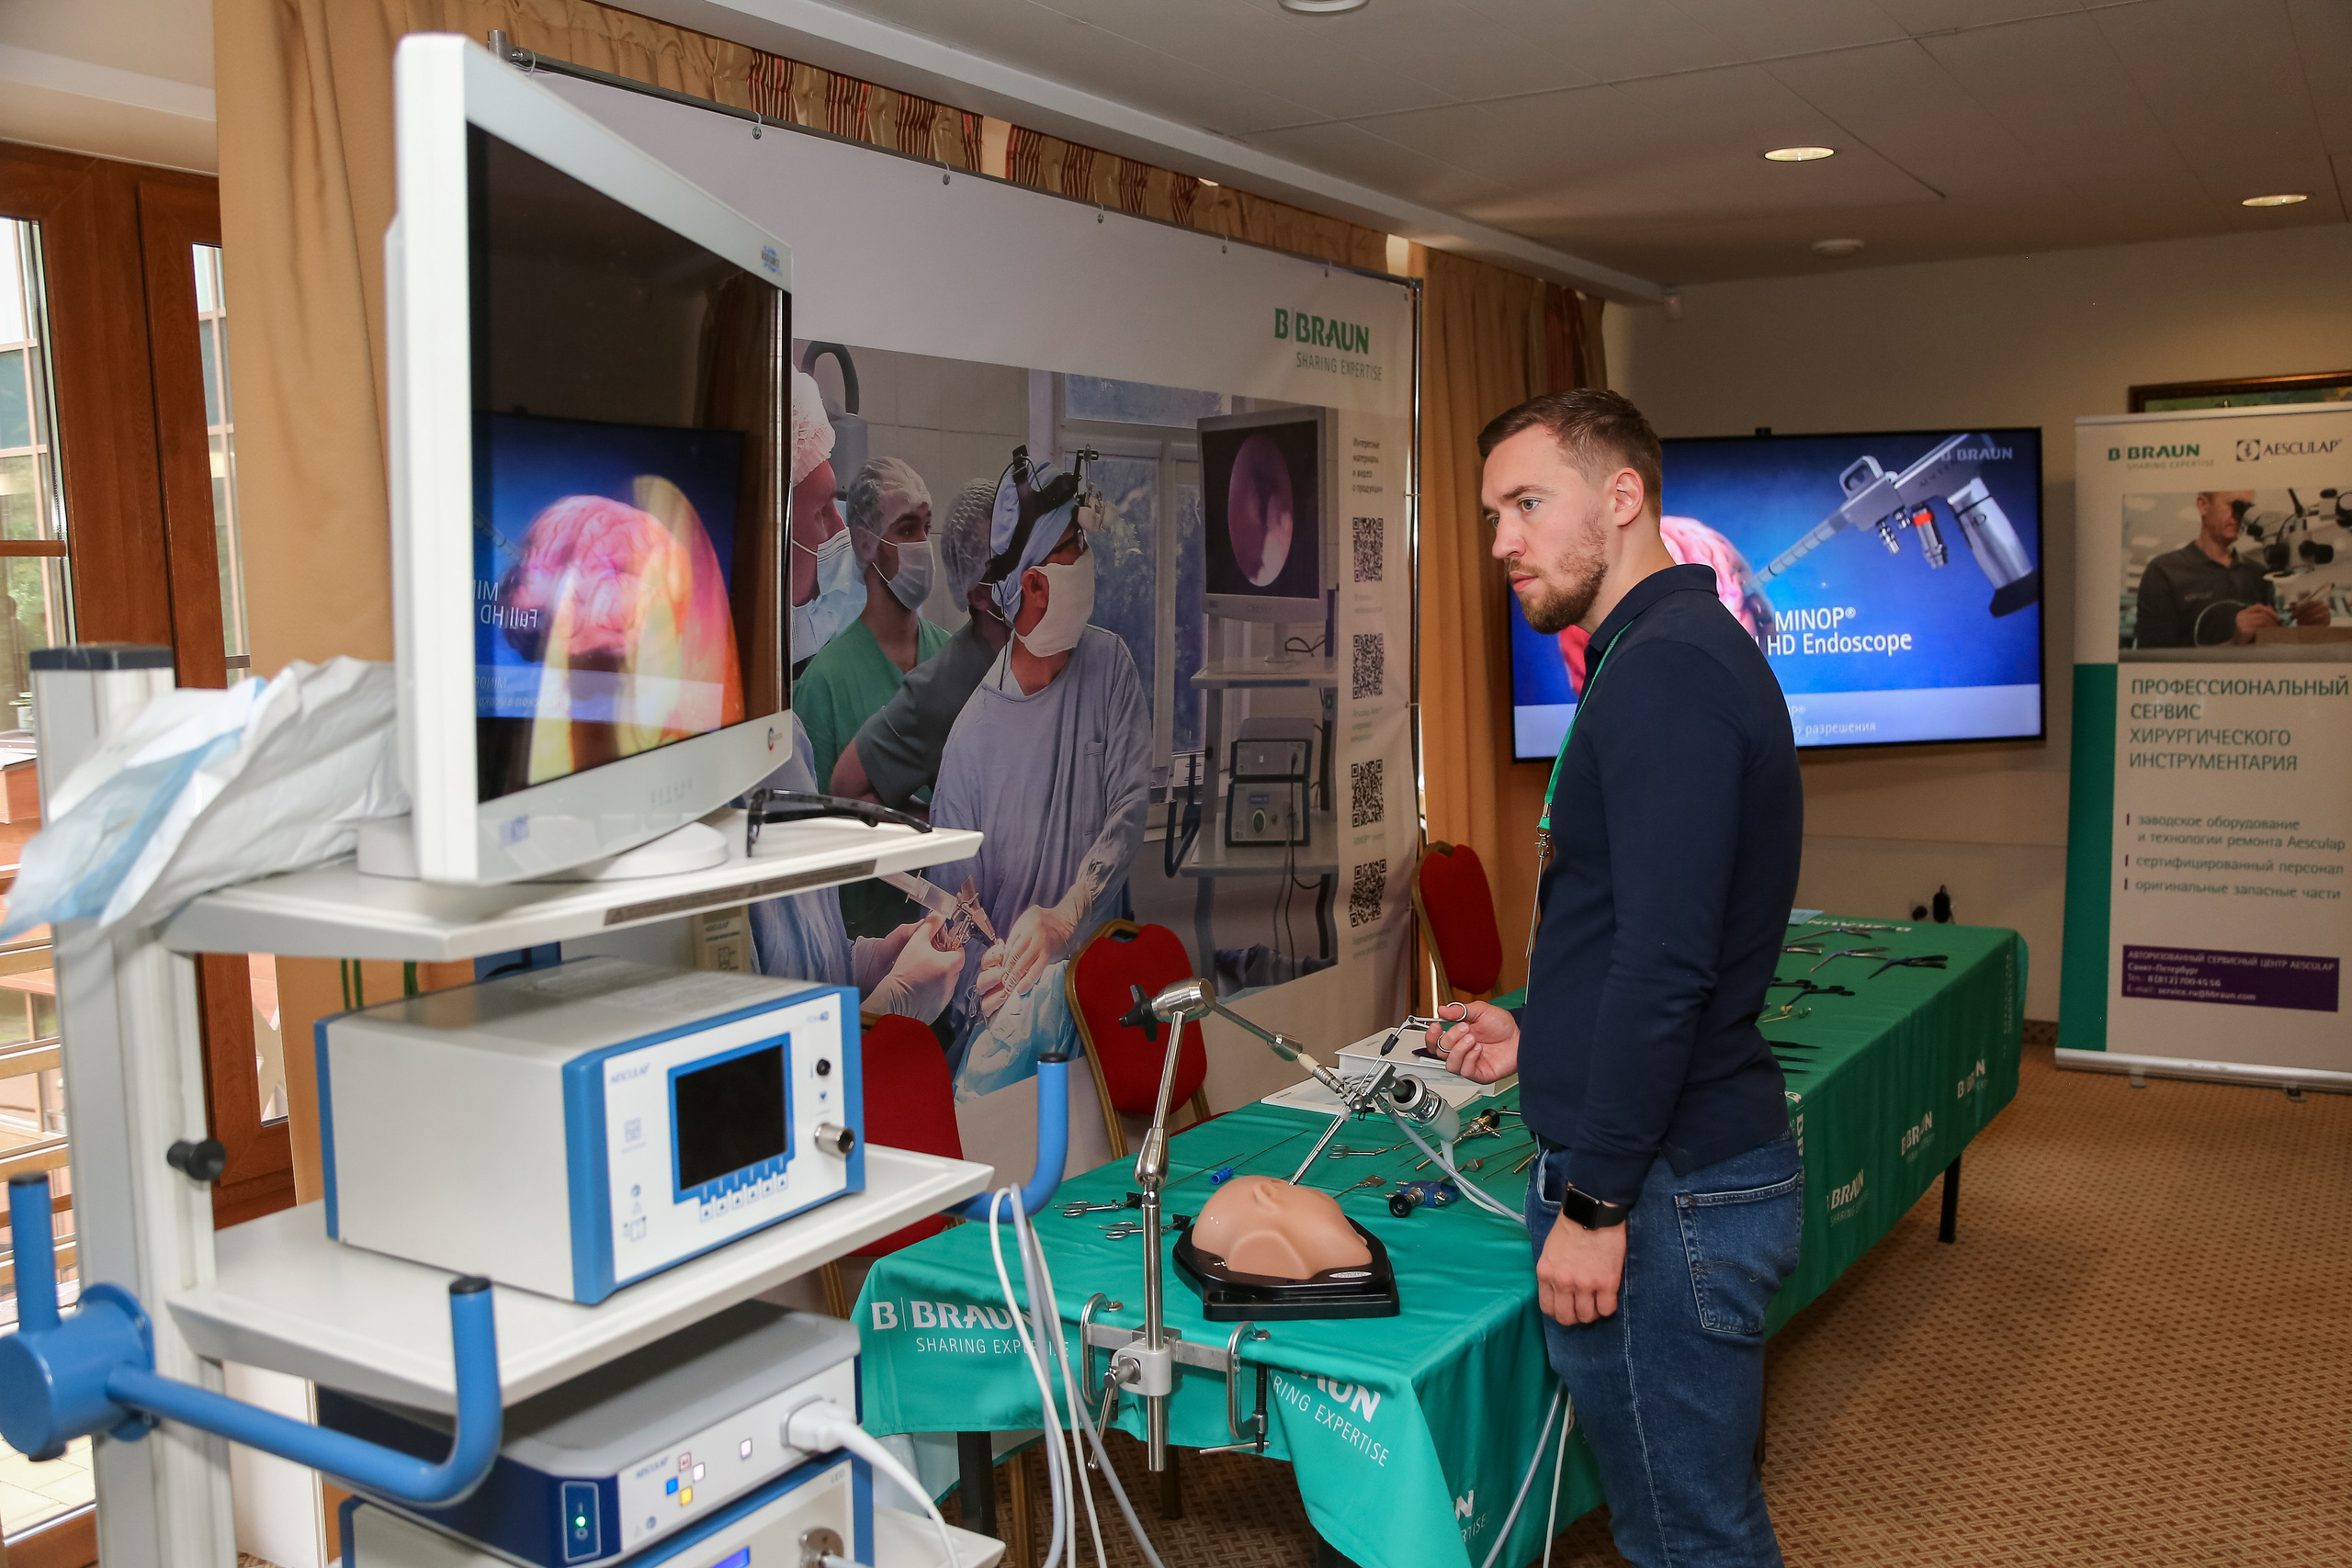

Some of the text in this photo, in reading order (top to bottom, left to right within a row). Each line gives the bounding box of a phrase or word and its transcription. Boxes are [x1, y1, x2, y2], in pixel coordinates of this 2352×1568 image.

[1295, 311, 1370, 355] BRAUN
[1296, 351, 1383, 381] SHARING EXPERTISE
[1957, 446, 2014, 461] BRAUN
[2128, 444, 2199, 460] BRAUN
[1767, 634, 1796, 656] HD
[1803, 632, 1912, 657] Endoscope
[2132, 675, 2349, 696] ПРОФЕССИОНАЛЬНЫЙ
[2131, 704, 2201, 719] СЕРВИС
[1805, 721, 1877, 738] разрешения
[2130, 728, 2291, 746] ХИРУРГИЧЕСКОГО
[2130, 752, 2298, 771] ИНСТРУМЕНТАРИЯ
[2138, 815, 2301, 830] заводское оборудование
[2138, 832, 2346, 851] и технологии ремонта Aesculap
[2136, 854, 2344, 876] сертифицированный персонал
[2135, 879, 2341, 899] оригинальные запасные части
[871, 1301, 899, 1330] B
[916, 1337, 986, 1354] SHARING
[1273, 1375, 1311, 1412] RING
[1314, 1404, 1389, 1467] EXPERTISE
[1462, 1512, 1487, 1542] RTISE
